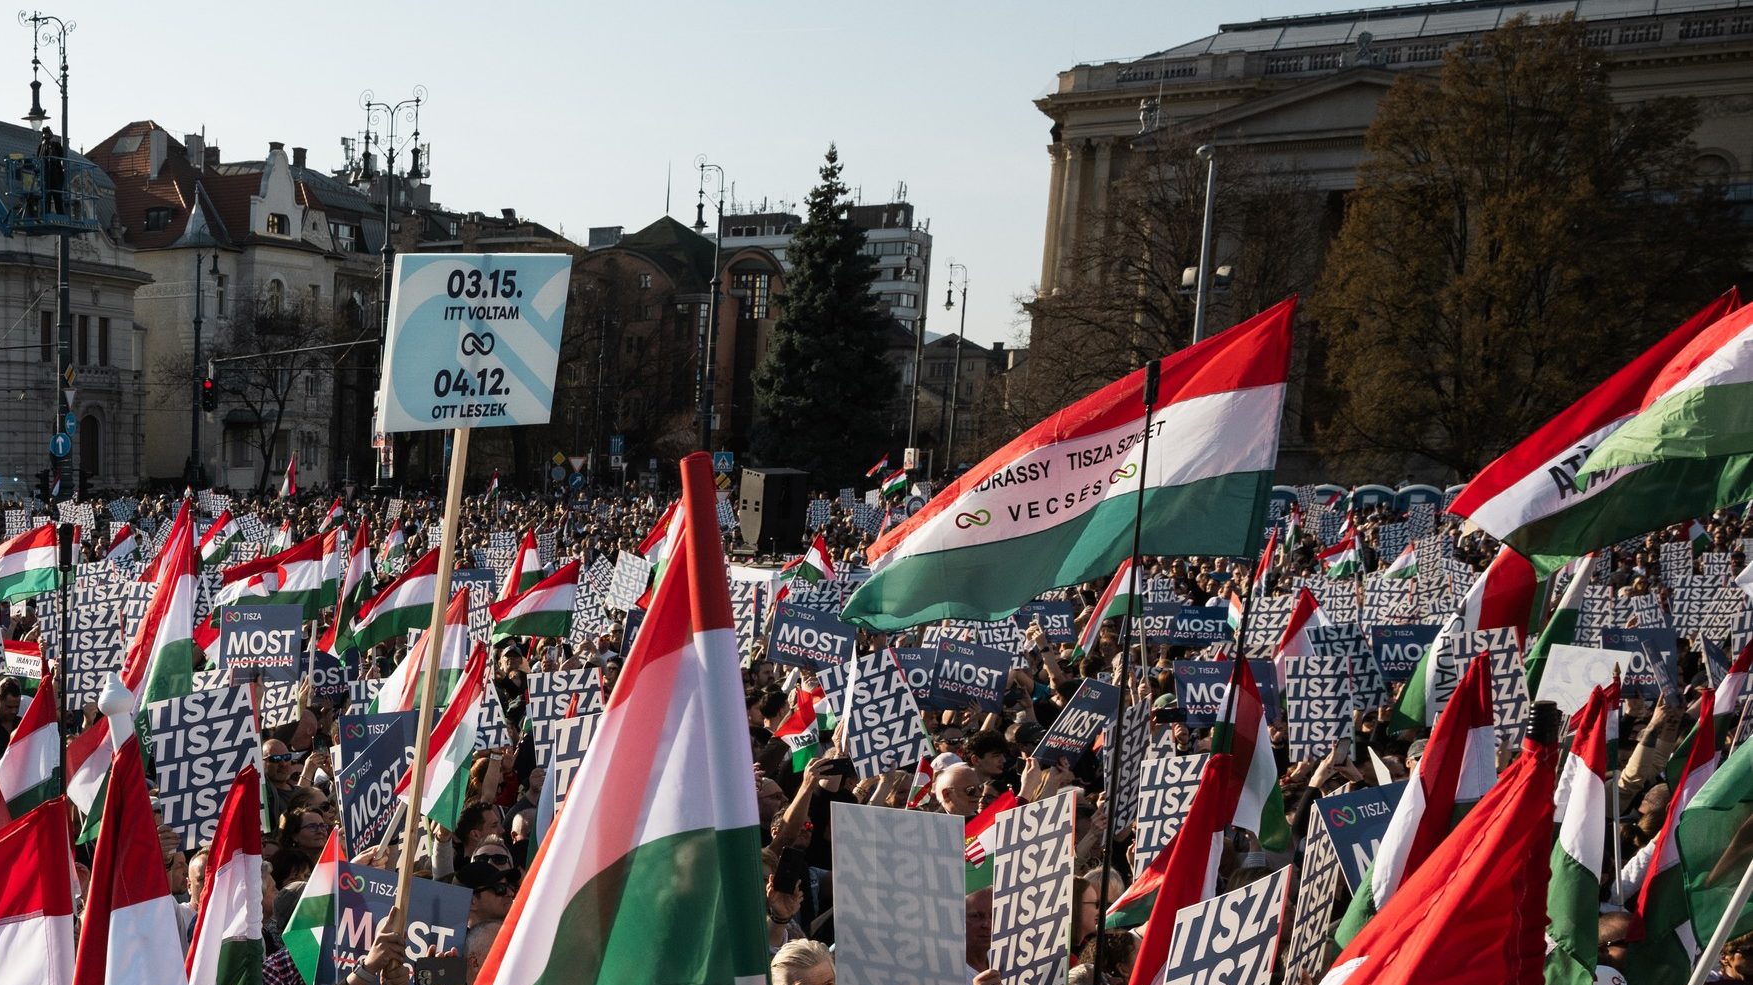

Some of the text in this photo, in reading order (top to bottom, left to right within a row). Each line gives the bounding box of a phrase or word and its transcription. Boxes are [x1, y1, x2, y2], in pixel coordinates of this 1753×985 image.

[447, 269, 523, 299] 03.15.
[444, 306, 519, 321] ITT VOLTAM
[433, 368, 510, 397] 04.12.
[431, 403, 508, 420] OTT LESZEK
[967, 420, 1167, 494] DRÁSSY TISZA SZIGET
[1008, 479, 1102, 522] VECSÉS
[1702, 552, 1731, 563] TISZA
[1703, 564, 1733, 575] TISZA
[1148, 579, 1175, 591] TISZA
[1324, 584, 1357, 596] TISZA
[1365, 577, 1411, 591] TISZA
[1675, 574, 1723, 587] TISZA
[1149, 591, 1175, 602] TISZA
[1325, 597, 1358, 610] TISZA
[243, 612, 262, 621] TISZA
[1326, 610, 1358, 623] TISZA
[227, 630, 296, 656] MOST
[777, 622, 848, 656] MOST
[1307, 624, 1364, 642] TISZA
[1450, 629, 1519, 655] TISZA
[776, 642, 807, 658] VAGY
[226, 655, 293, 670] VAGY SOHA!
[1198, 667, 1220, 675] TISZA
[1286, 656, 1351, 676] TISZA
[1382, 662, 1414, 671] VAGY
[528, 667, 601, 693] TISZA
[939, 659, 1003, 690] MOST
[938, 680, 998, 700] VAGY SOHA!
[1287, 678, 1352, 698] TISZA
[147, 684, 252, 730] TISZA
[1289, 700, 1353, 720] TISZA
[1054, 708, 1106, 738] MOST
[1290, 722, 1354, 742] TISZA
[152, 716, 256, 761] TISZA
[850, 715, 927, 759] TISZA
[357, 760, 372, 777] TISZA
[854, 737, 936, 781] TISZA
[350, 758, 402, 839] MOST
[1357, 801, 1392, 817] TISZA
[996, 791, 1074, 850] TISZA
[994, 832, 1074, 893] TISZA
[993, 873, 1073, 935] TISZA
[1169, 865, 1287, 970] TISZA
[991, 914, 1071, 973] TISZA
